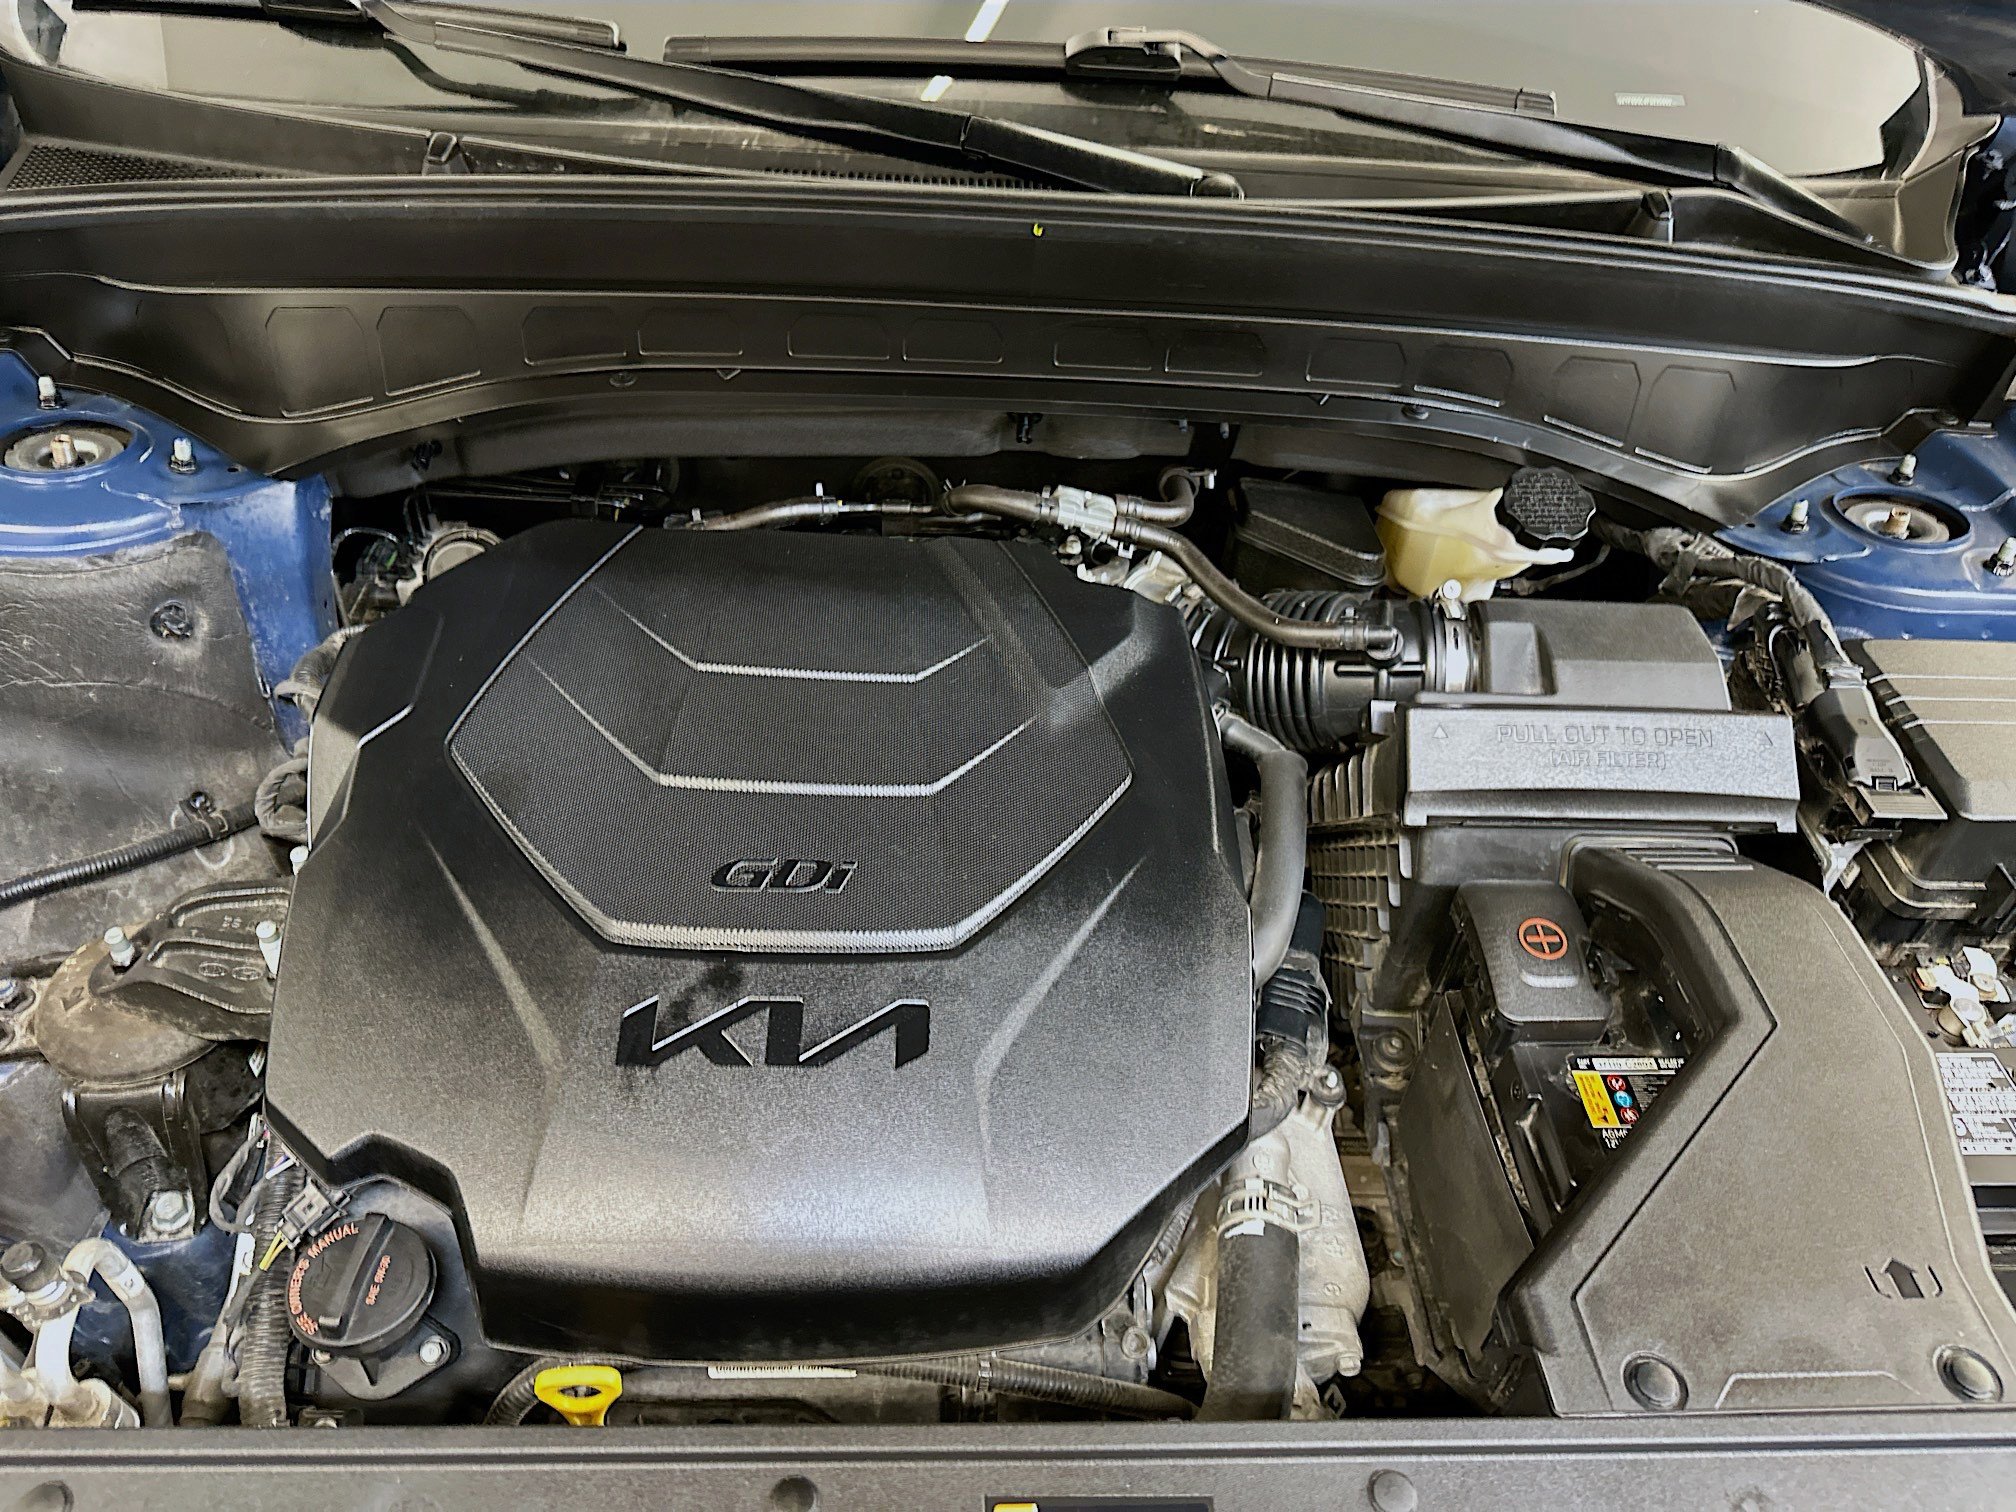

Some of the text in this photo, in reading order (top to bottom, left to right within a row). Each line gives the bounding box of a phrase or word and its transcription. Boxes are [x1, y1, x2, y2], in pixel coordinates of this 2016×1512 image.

[1498, 725, 1714, 748] PULL OUT TO OPEN
[616, 994, 930, 1069] KIA
[307, 1222, 360, 1259] MANUAL
